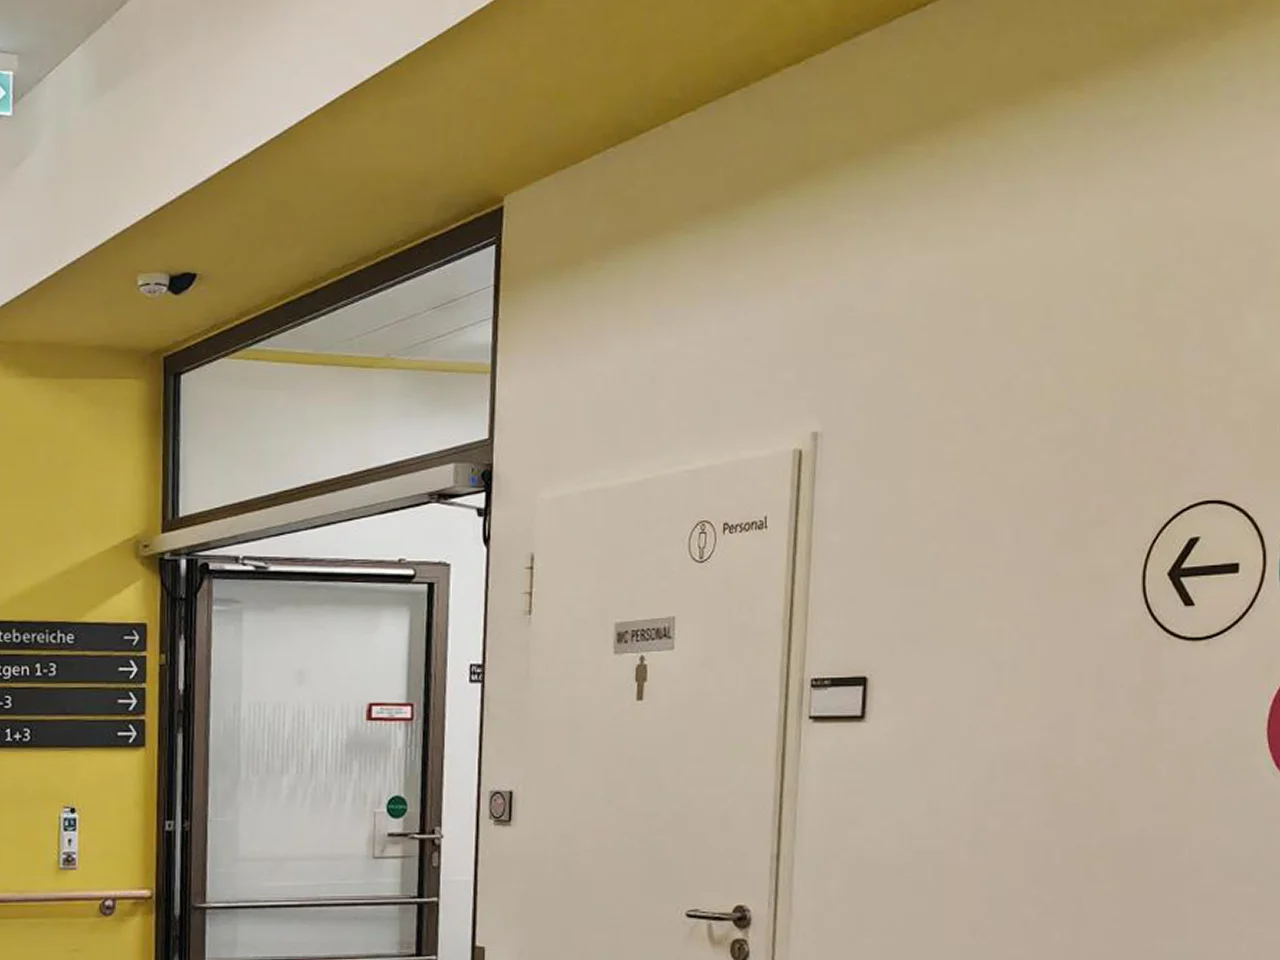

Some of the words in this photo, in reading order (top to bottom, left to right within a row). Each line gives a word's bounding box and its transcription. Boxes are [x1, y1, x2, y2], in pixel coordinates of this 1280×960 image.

[722, 515, 768, 535] Personal
[631, 626, 672, 643] PERSONAL
[35, 663, 57, 676] 1-3
[5, 728, 31, 742] 1+3
